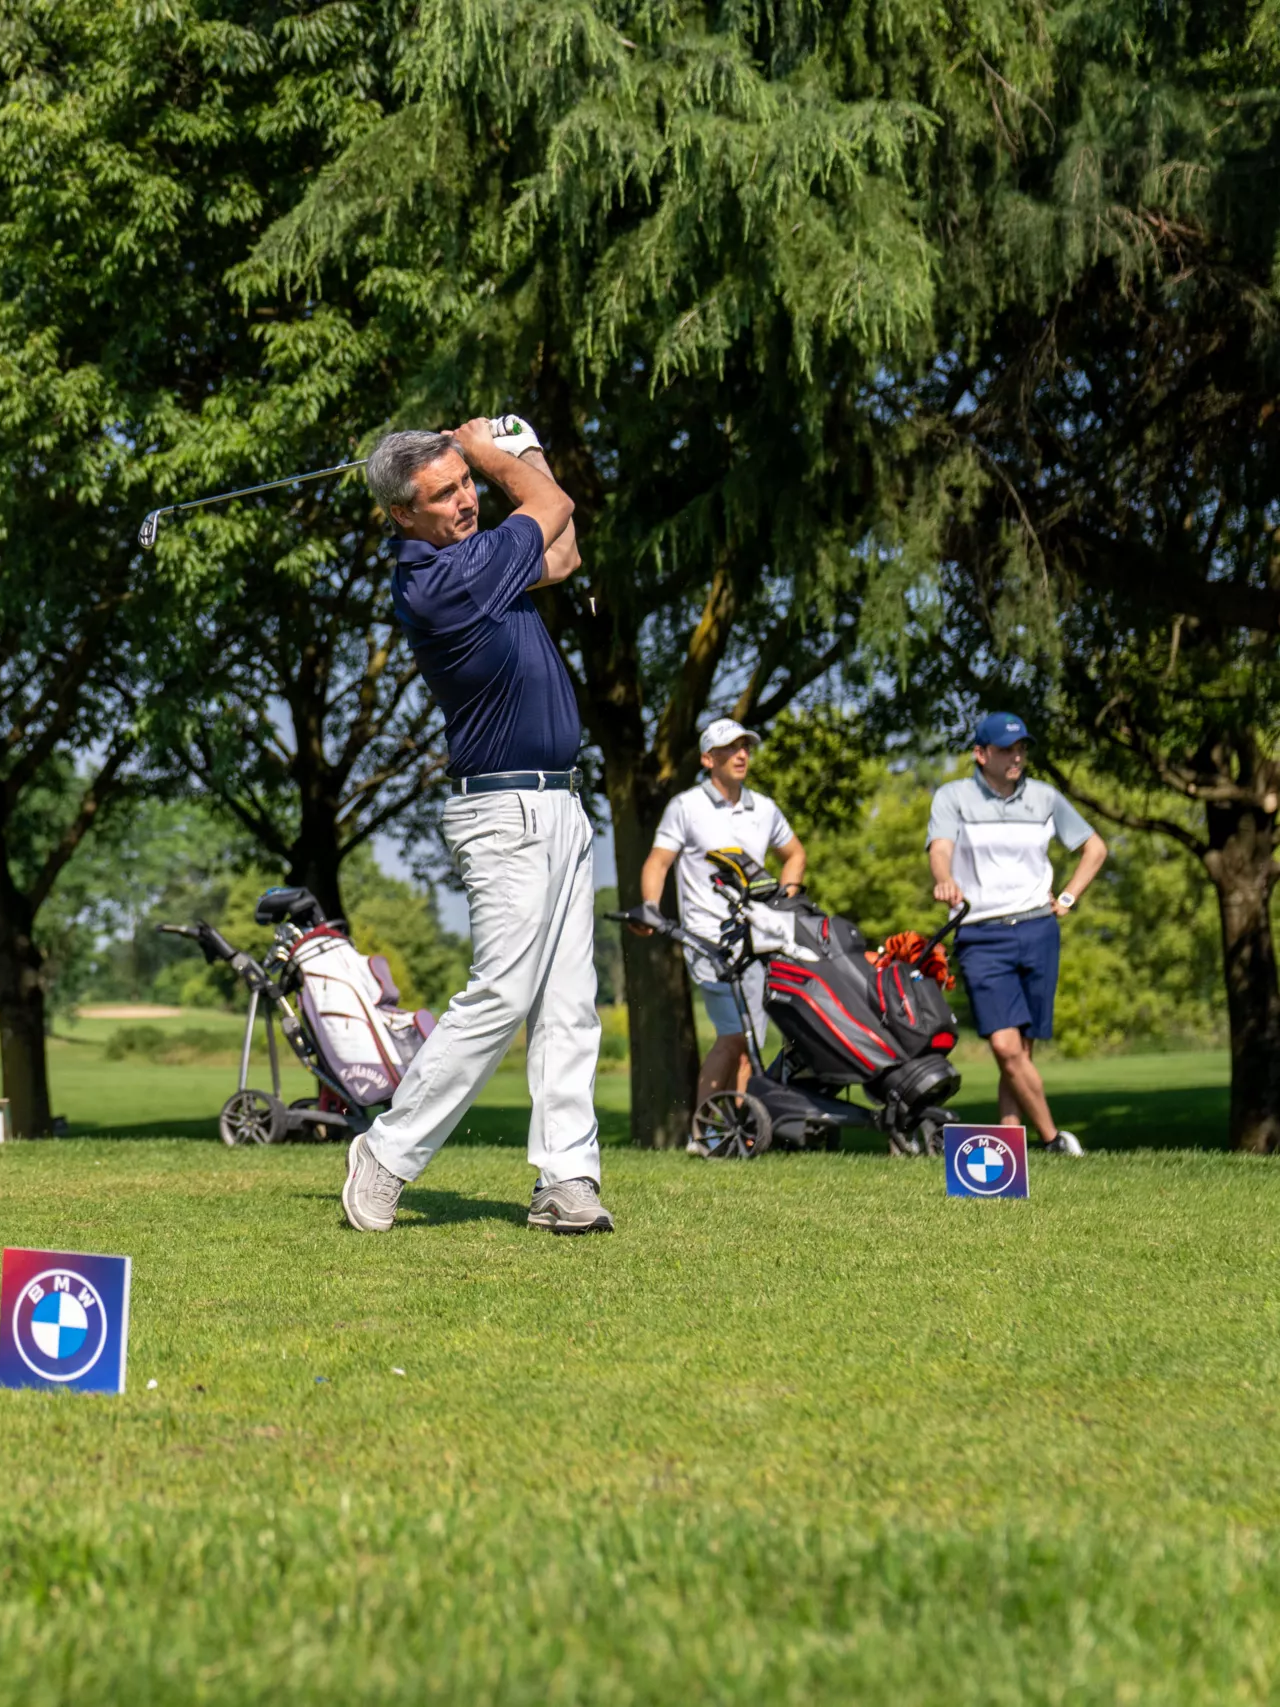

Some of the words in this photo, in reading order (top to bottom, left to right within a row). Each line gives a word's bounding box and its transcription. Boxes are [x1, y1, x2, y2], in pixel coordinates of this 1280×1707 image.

[340, 1064, 389, 1089] Callaway
[963, 1138, 1007, 1154] BMW
[28, 1275, 95, 1308] BMW
